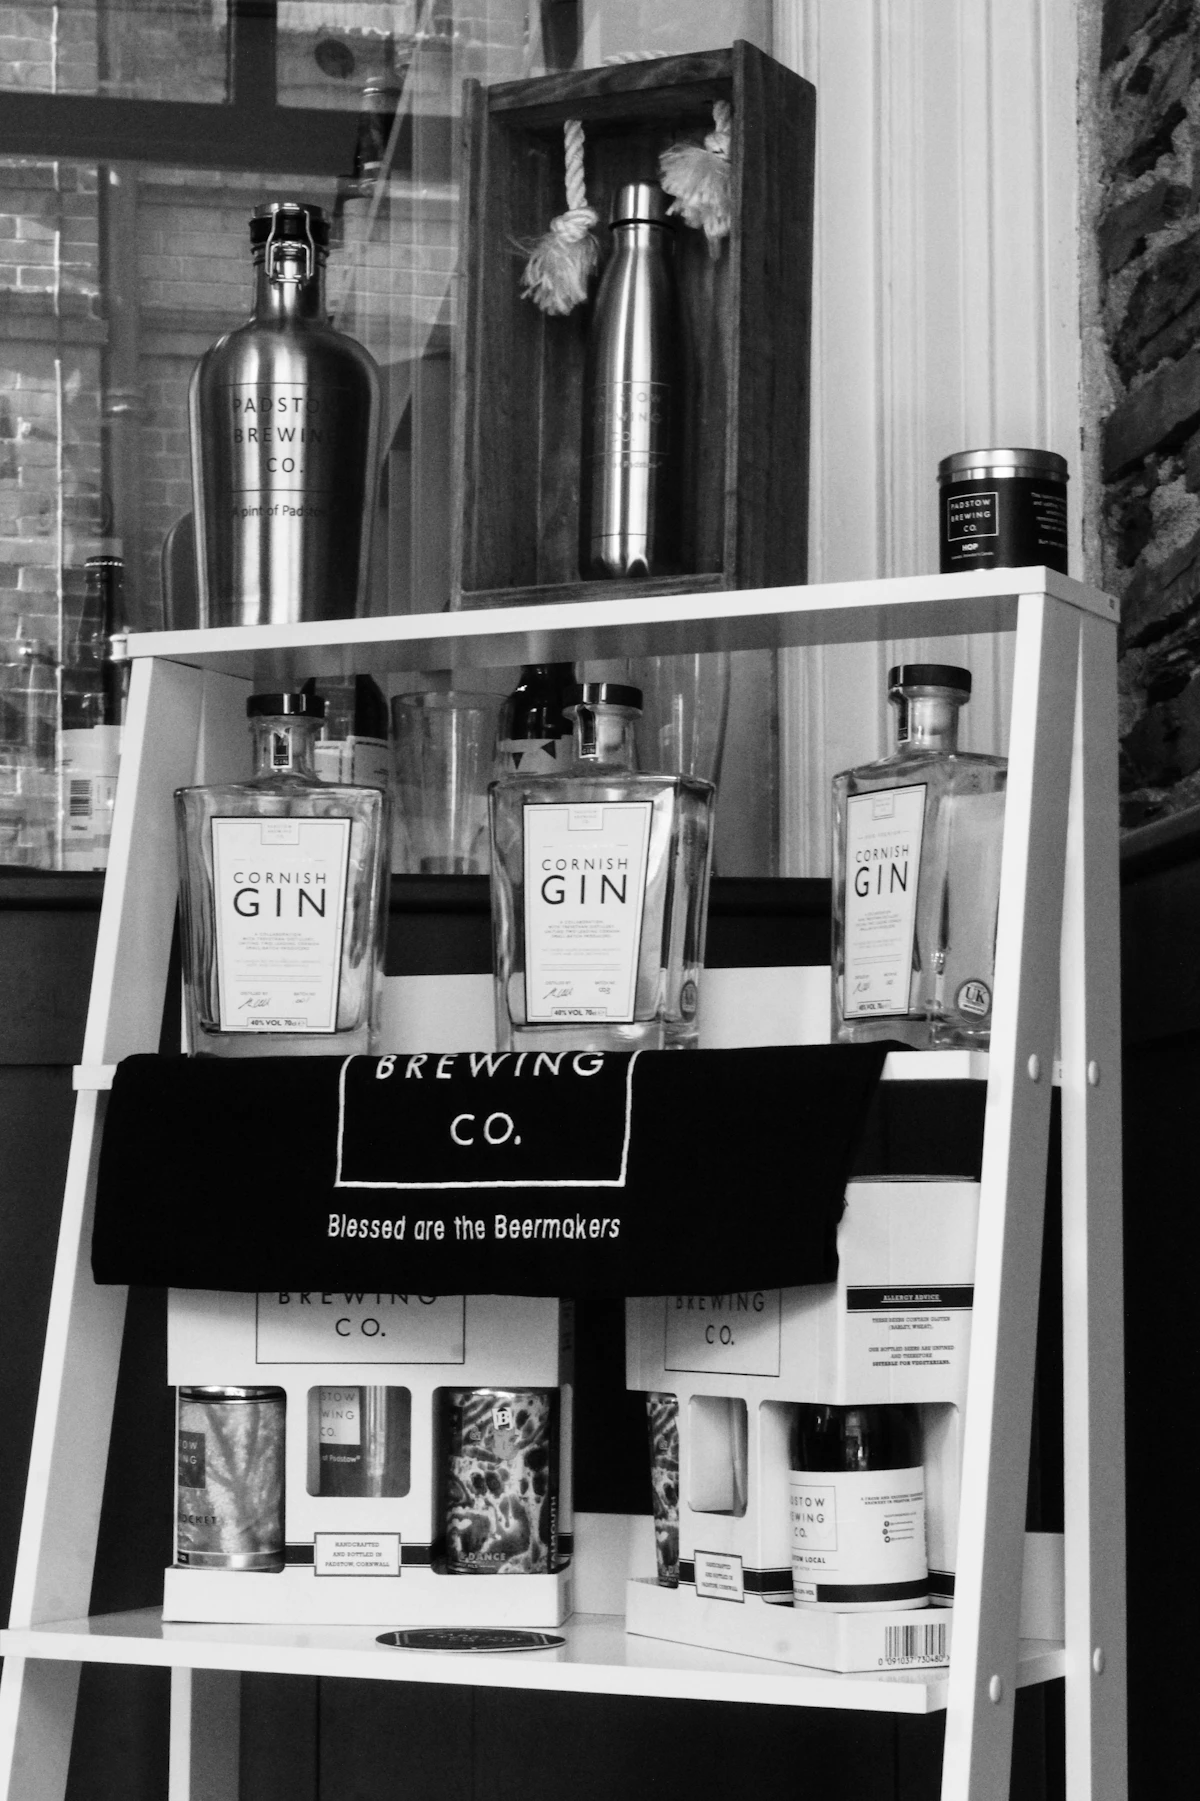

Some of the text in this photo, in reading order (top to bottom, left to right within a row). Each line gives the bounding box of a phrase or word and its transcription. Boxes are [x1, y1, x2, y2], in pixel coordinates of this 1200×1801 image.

[266, 457, 304, 473] CO.
[242, 506, 264, 518] pint
[268, 505, 279, 516] of
[951, 498, 991, 510] PADSTOW
[951, 511, 991, 522] BREWING
[855, 843, 909, 863] CORNISH
[541, 858, 628, 871] CORNISH
[233, 872, 326, 884] CORNISH
[854, 860, 908, 897] GIN
[541, 874, 626, 905] GIN
[233, 887, 325, 917] GIN
[965, 986, 987, 1004] UK
[375, 1052, 604, 1079] BREWING
[450, 1112, 521, 1146] CO.
[328, 1213, 620, 1240] Blessed are the Beermakers
[335, 1318, 385, 1337] CO.
[705, 1325, 735, 1346] CO.
[182, 1440, 198, 1449] OW
[468, 1552, 506, 1561] DANCE
[878, 1657, 883, 1666] 0
[887, 1656, 914, 1666] 091037
